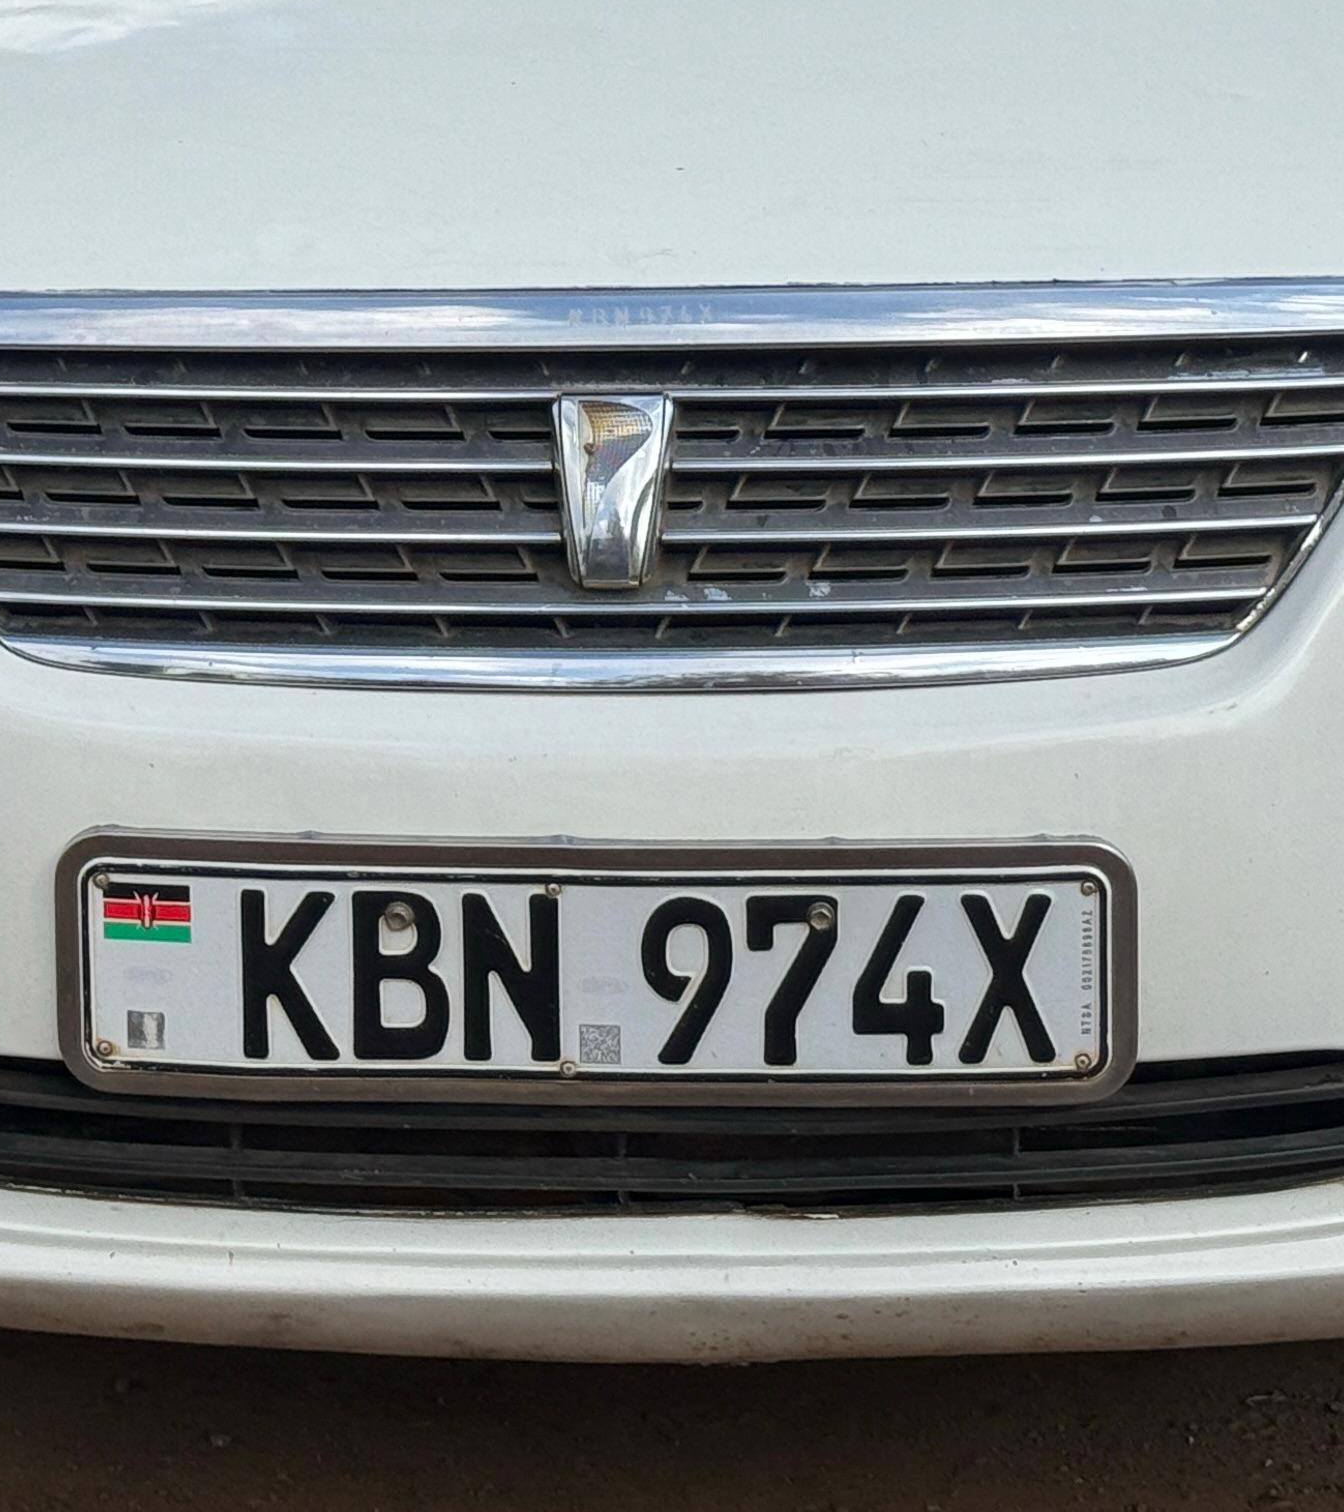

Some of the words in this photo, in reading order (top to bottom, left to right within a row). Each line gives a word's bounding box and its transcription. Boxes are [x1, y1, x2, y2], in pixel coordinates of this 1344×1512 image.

[240, 889, 561, 1062] KBN
[640, 894, 1056, 1066] 974X
[1081, 1003, 1092, 1035] NTSA
